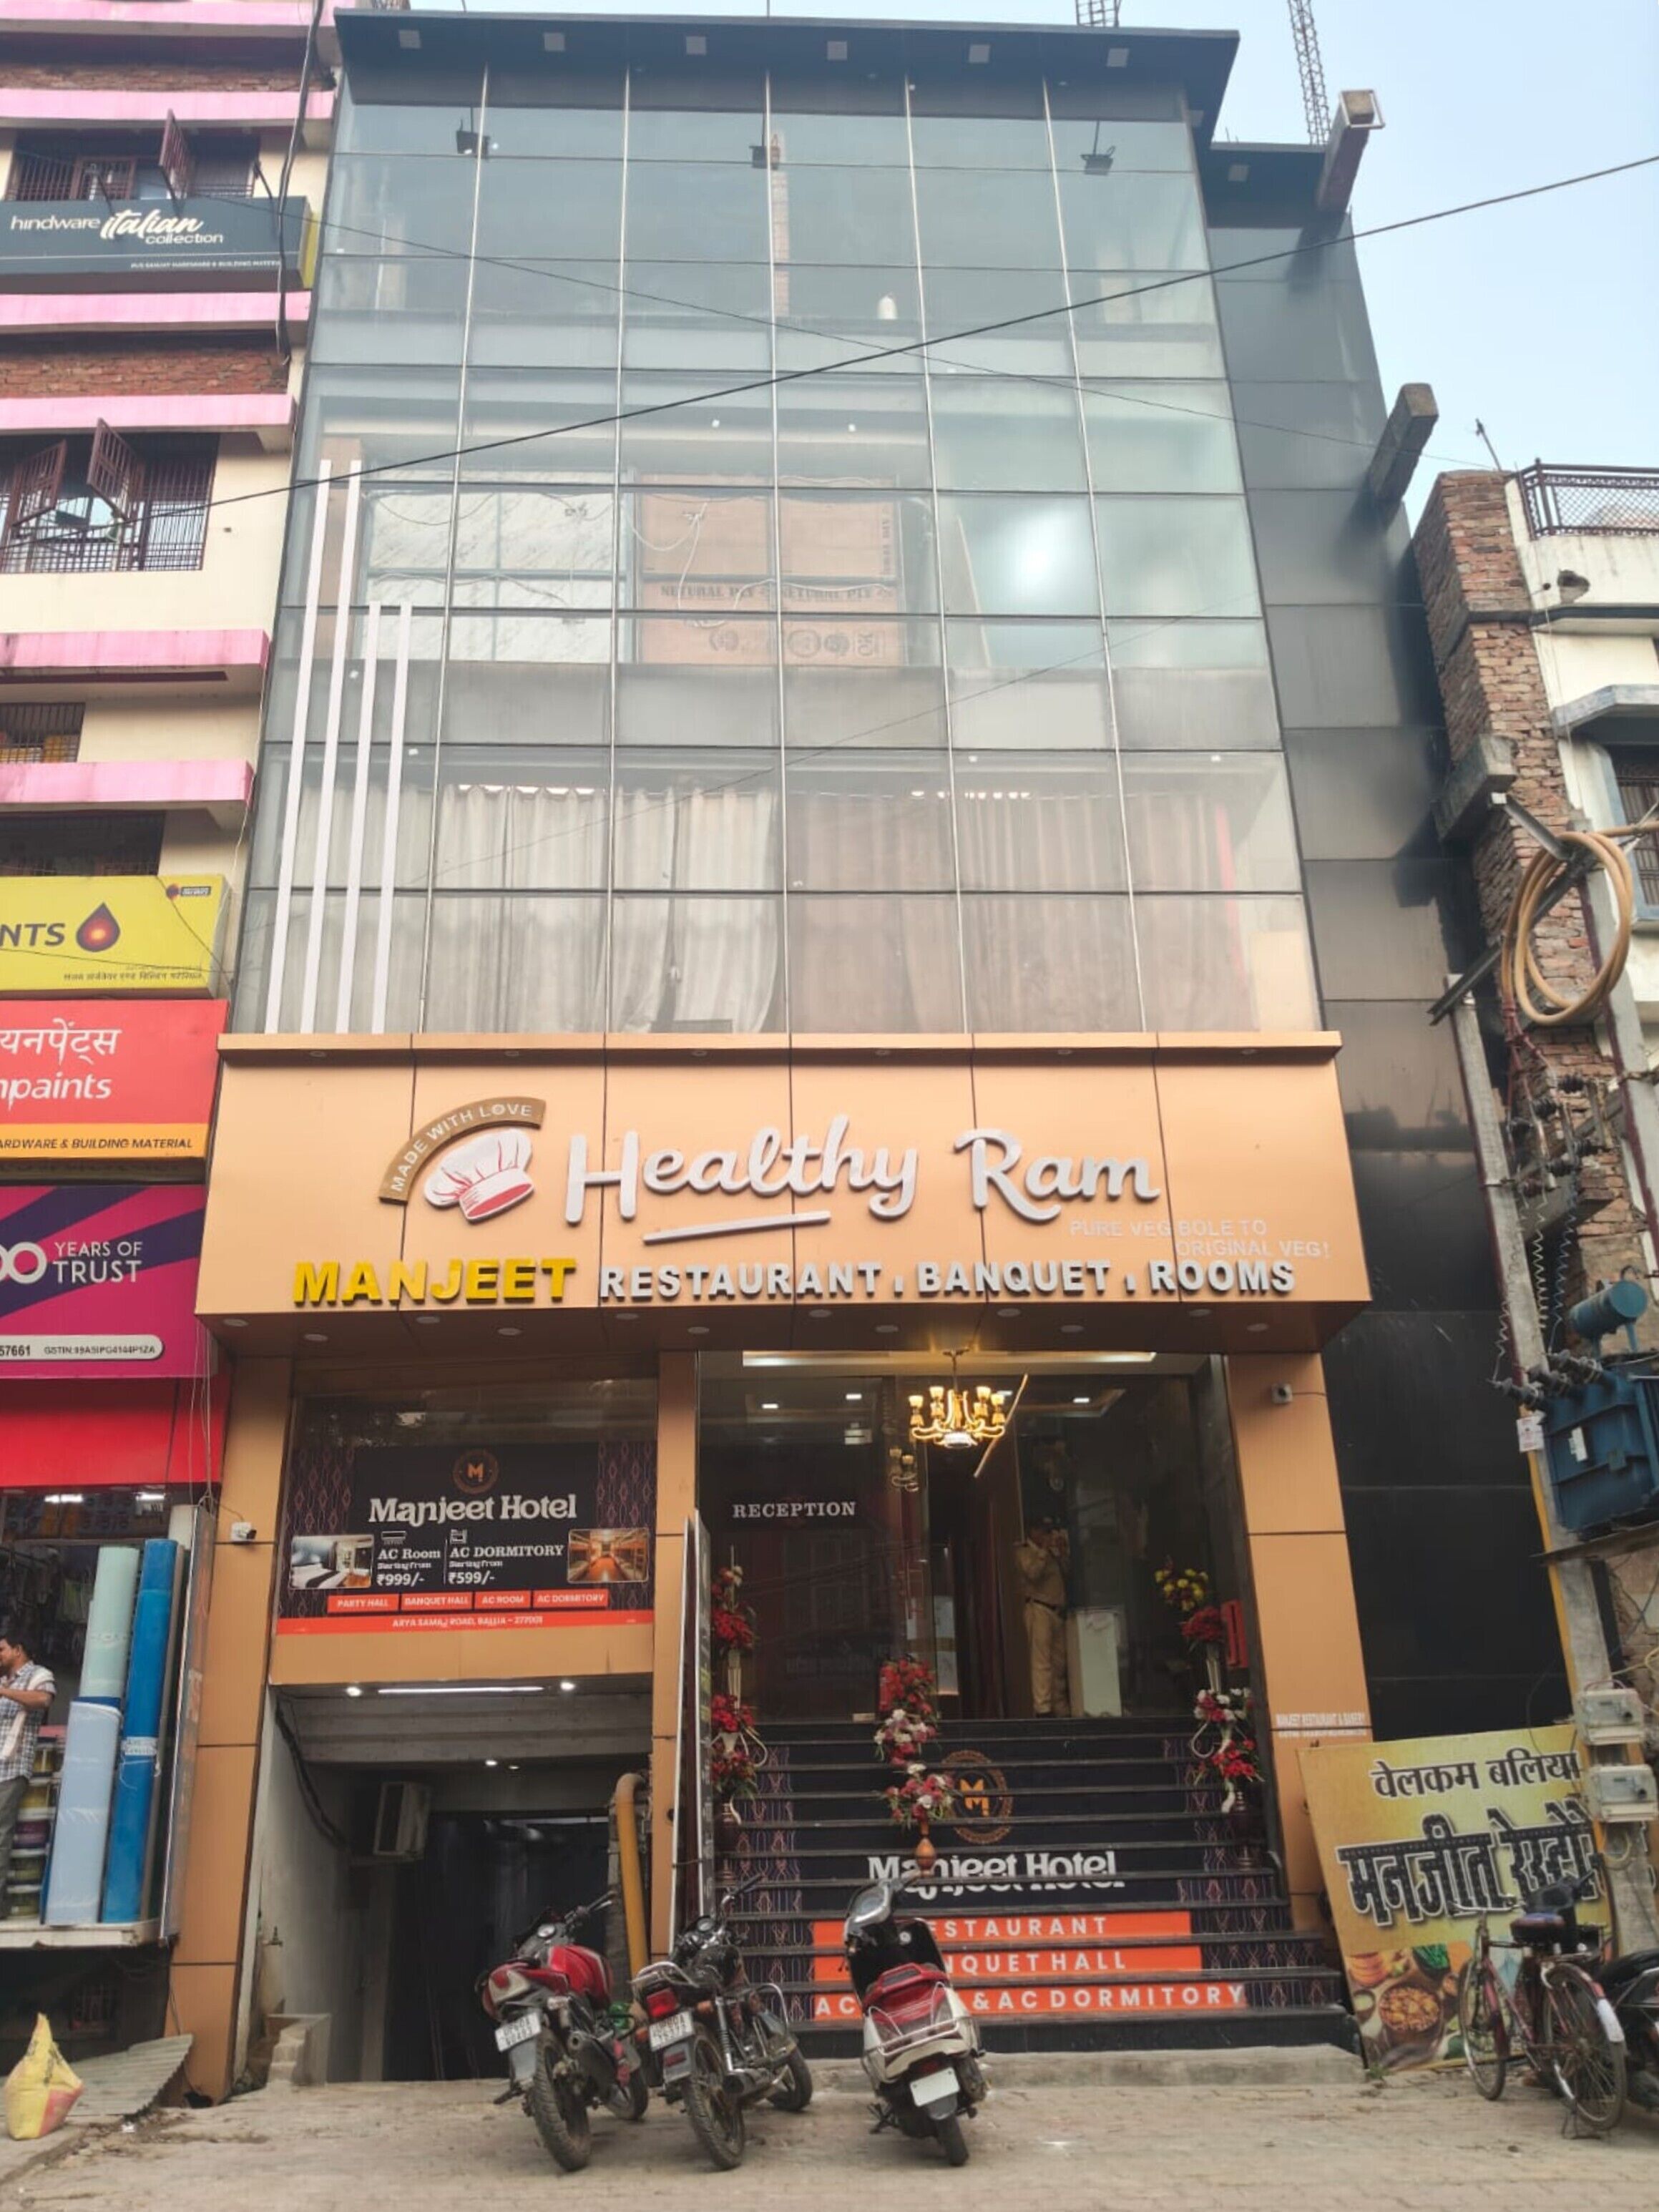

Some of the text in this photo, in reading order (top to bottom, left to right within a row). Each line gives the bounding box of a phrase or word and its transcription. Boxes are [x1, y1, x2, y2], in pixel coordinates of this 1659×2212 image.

[10, 209, 205, 240] hindware italian
[145, 233, 224, 245] collection
[0, 922, 66, 947] NTS
[59, 1139, 68, 1149] &
[72, 1138, 129, 1149] BUILDING
[132, 1137, 192, 1148] MATERIAL
[391, 1102, 534, 1193] MADE WITH LOVE
[565, 1113, 1161, 1224] Healthy Ram
[1070, 1219, 1268, 1238] PURE VEG BOLE TO
[54, 1241, 143, 1257] YEARS OF
[1176, 1239, 1272, 1257] ORIGINAL
[53, 1260, 142, 1284] TRUST
[292, 1258, 577, 1307] MANJEET
[600, 1262, 881, 1301] RESTAURANT
[916, 1258, 1112, 1297] BANQUET
[1149, 1258, 1296, 1296] ROOMS
[368, 1494, 578, 1527] Manjeet Hotel
[732, 1501, 856, 1519] RECEPTION
[378, 1548, 441, 1560] AC Room
[450, 1544, 564, 1558] AC DORMITORY
[376, 1572, 424, 1587] ₹999/-
[449, 1570, 496, 1585] ₹599/-
[482, 1595, 524, 1605] AC ROOM
[537, 1595, 550, 1603] AC
[1371, 1747, 1580, 1797] वेलकम बलिया
[1024, 1851, 1125, 1891] Hotel
[1336, 1811, 1508, 1926] मनजीत
[930, 1917, 1107, 1938] STAURANT
[944, 1951, 1125, 1977] NQUET HALL
[815, 1985, 1243, 2015] AC & AC DORMITORY
